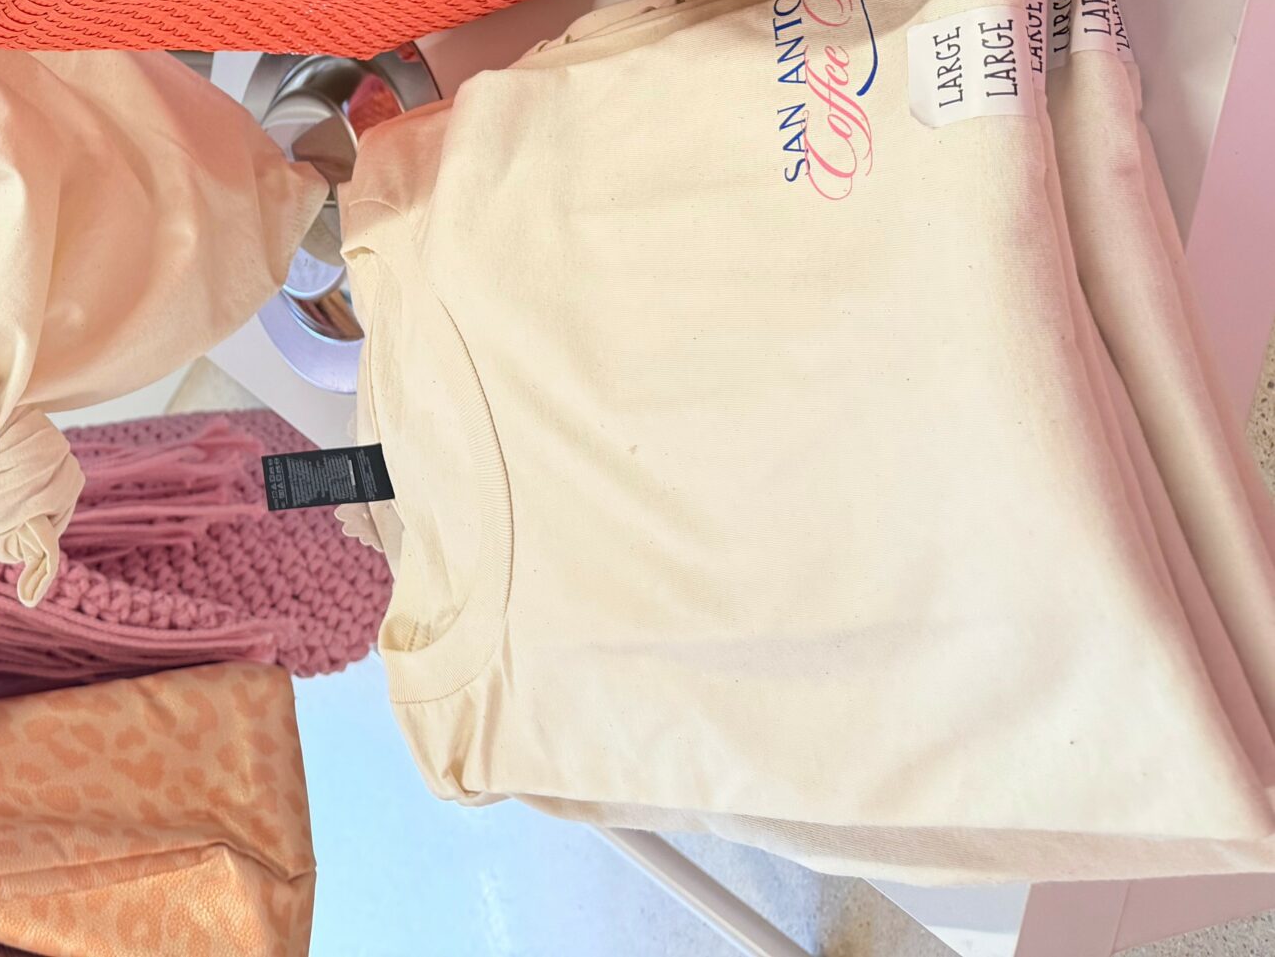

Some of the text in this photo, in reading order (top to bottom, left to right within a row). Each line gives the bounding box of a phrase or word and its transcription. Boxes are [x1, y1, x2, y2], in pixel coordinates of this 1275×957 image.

[933, 26, 963, 107] LARGE
[979, 19, 1017, 97] LARGE
[777, 103, 810, 182] SAN
[803, 46, 873, 200] Coffee
